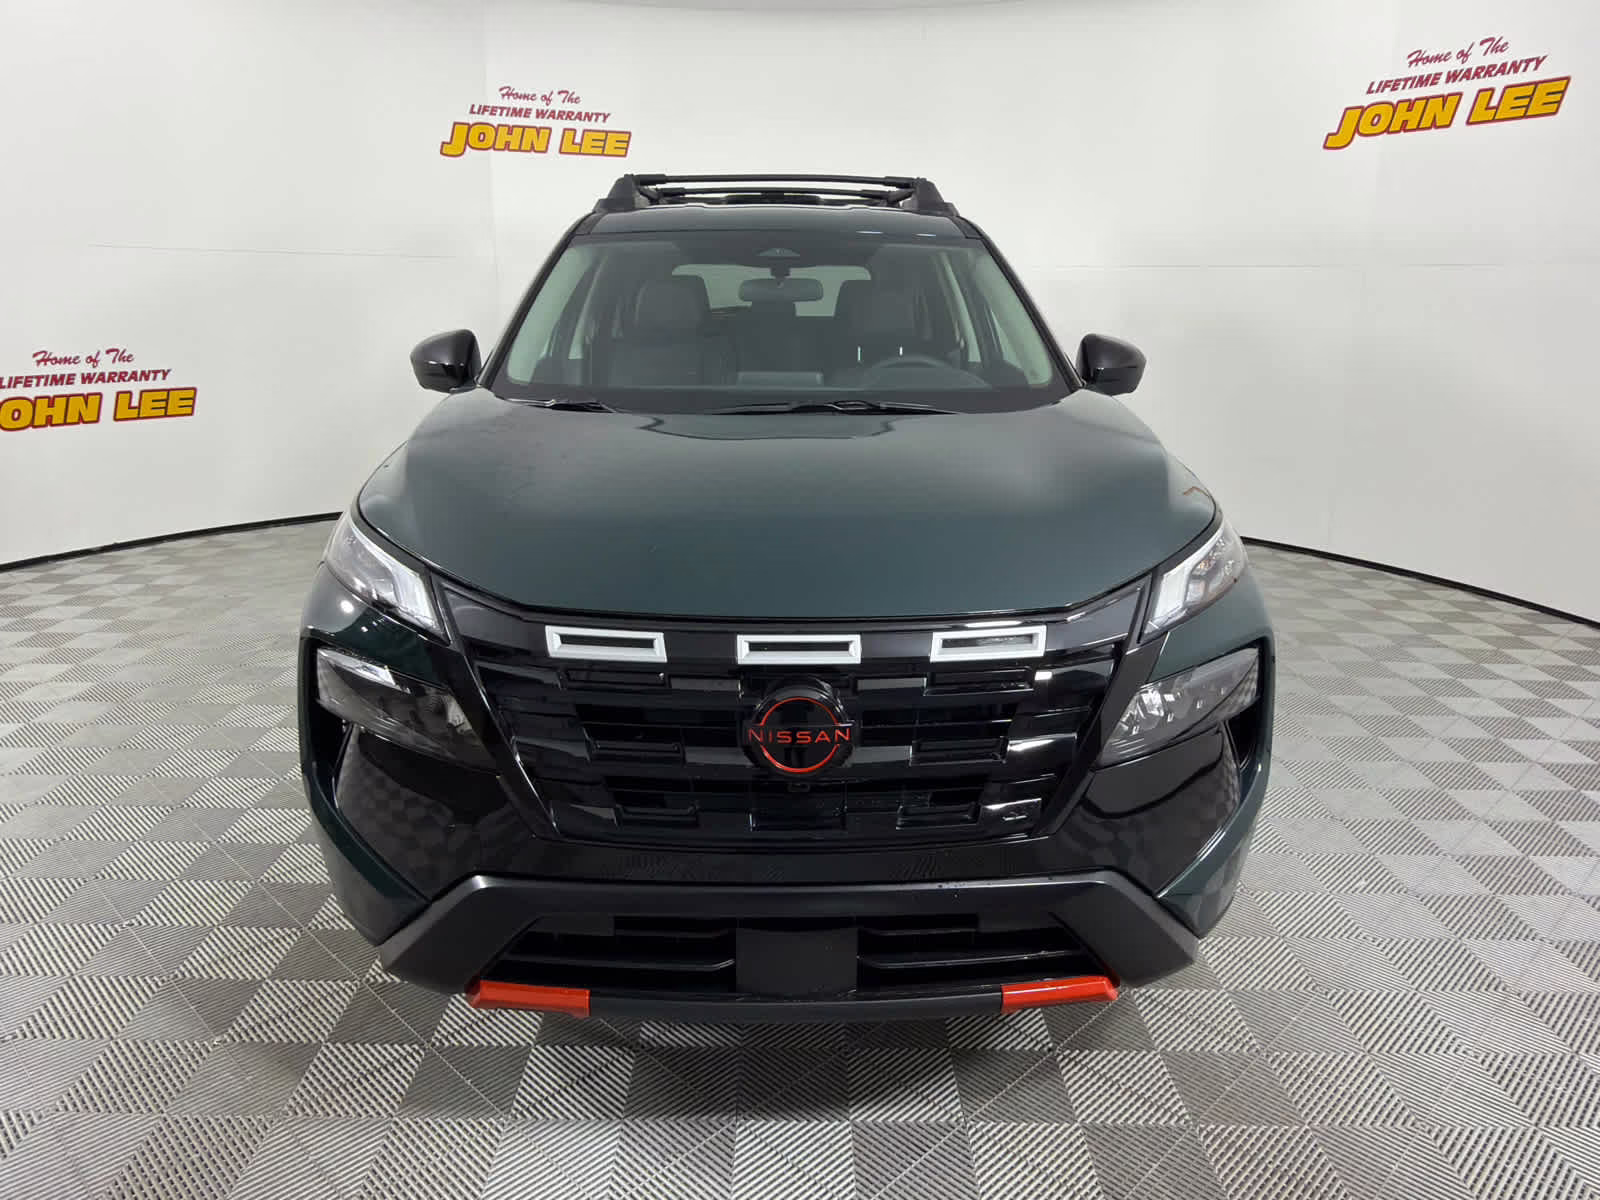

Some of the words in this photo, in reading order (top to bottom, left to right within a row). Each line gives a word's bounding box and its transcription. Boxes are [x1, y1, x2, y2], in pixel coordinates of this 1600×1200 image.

[1407, 49, 1451, 68] Home
[1456, 42, 1474, 65] of
[1479, 36, 1509, 56] The
[1366, 73, 1442, 95] LIFETIME
[1445, 55, 1548, 84] WARRANTY
[499, 86, 537, 101] Home
[540, 91, 553, 105] of
[557, 90, 581, 104] The
[469, 104, 533, 119] LIFETIME
[535, 109, 611, 123] WARRANTY
[1323, 92, 1463, 150] JOHN
[1466, 76, 1571, 126] LEE
[440, 122, 552, 157] JOHN
[559, 128, 632, 158] LEE
[32, 350, 81, 367] Home
[85, 350, 100, 368] of
[105, 348, 134, 363] The
[0, 373, 76, 389] LIFETIME
[80, 369, 171, 385] WARRANTY
[0, 392, 103, 431] OHN
[113, 387, 197, 421] LEE
[748, 728, 851, 744] NISSAN
